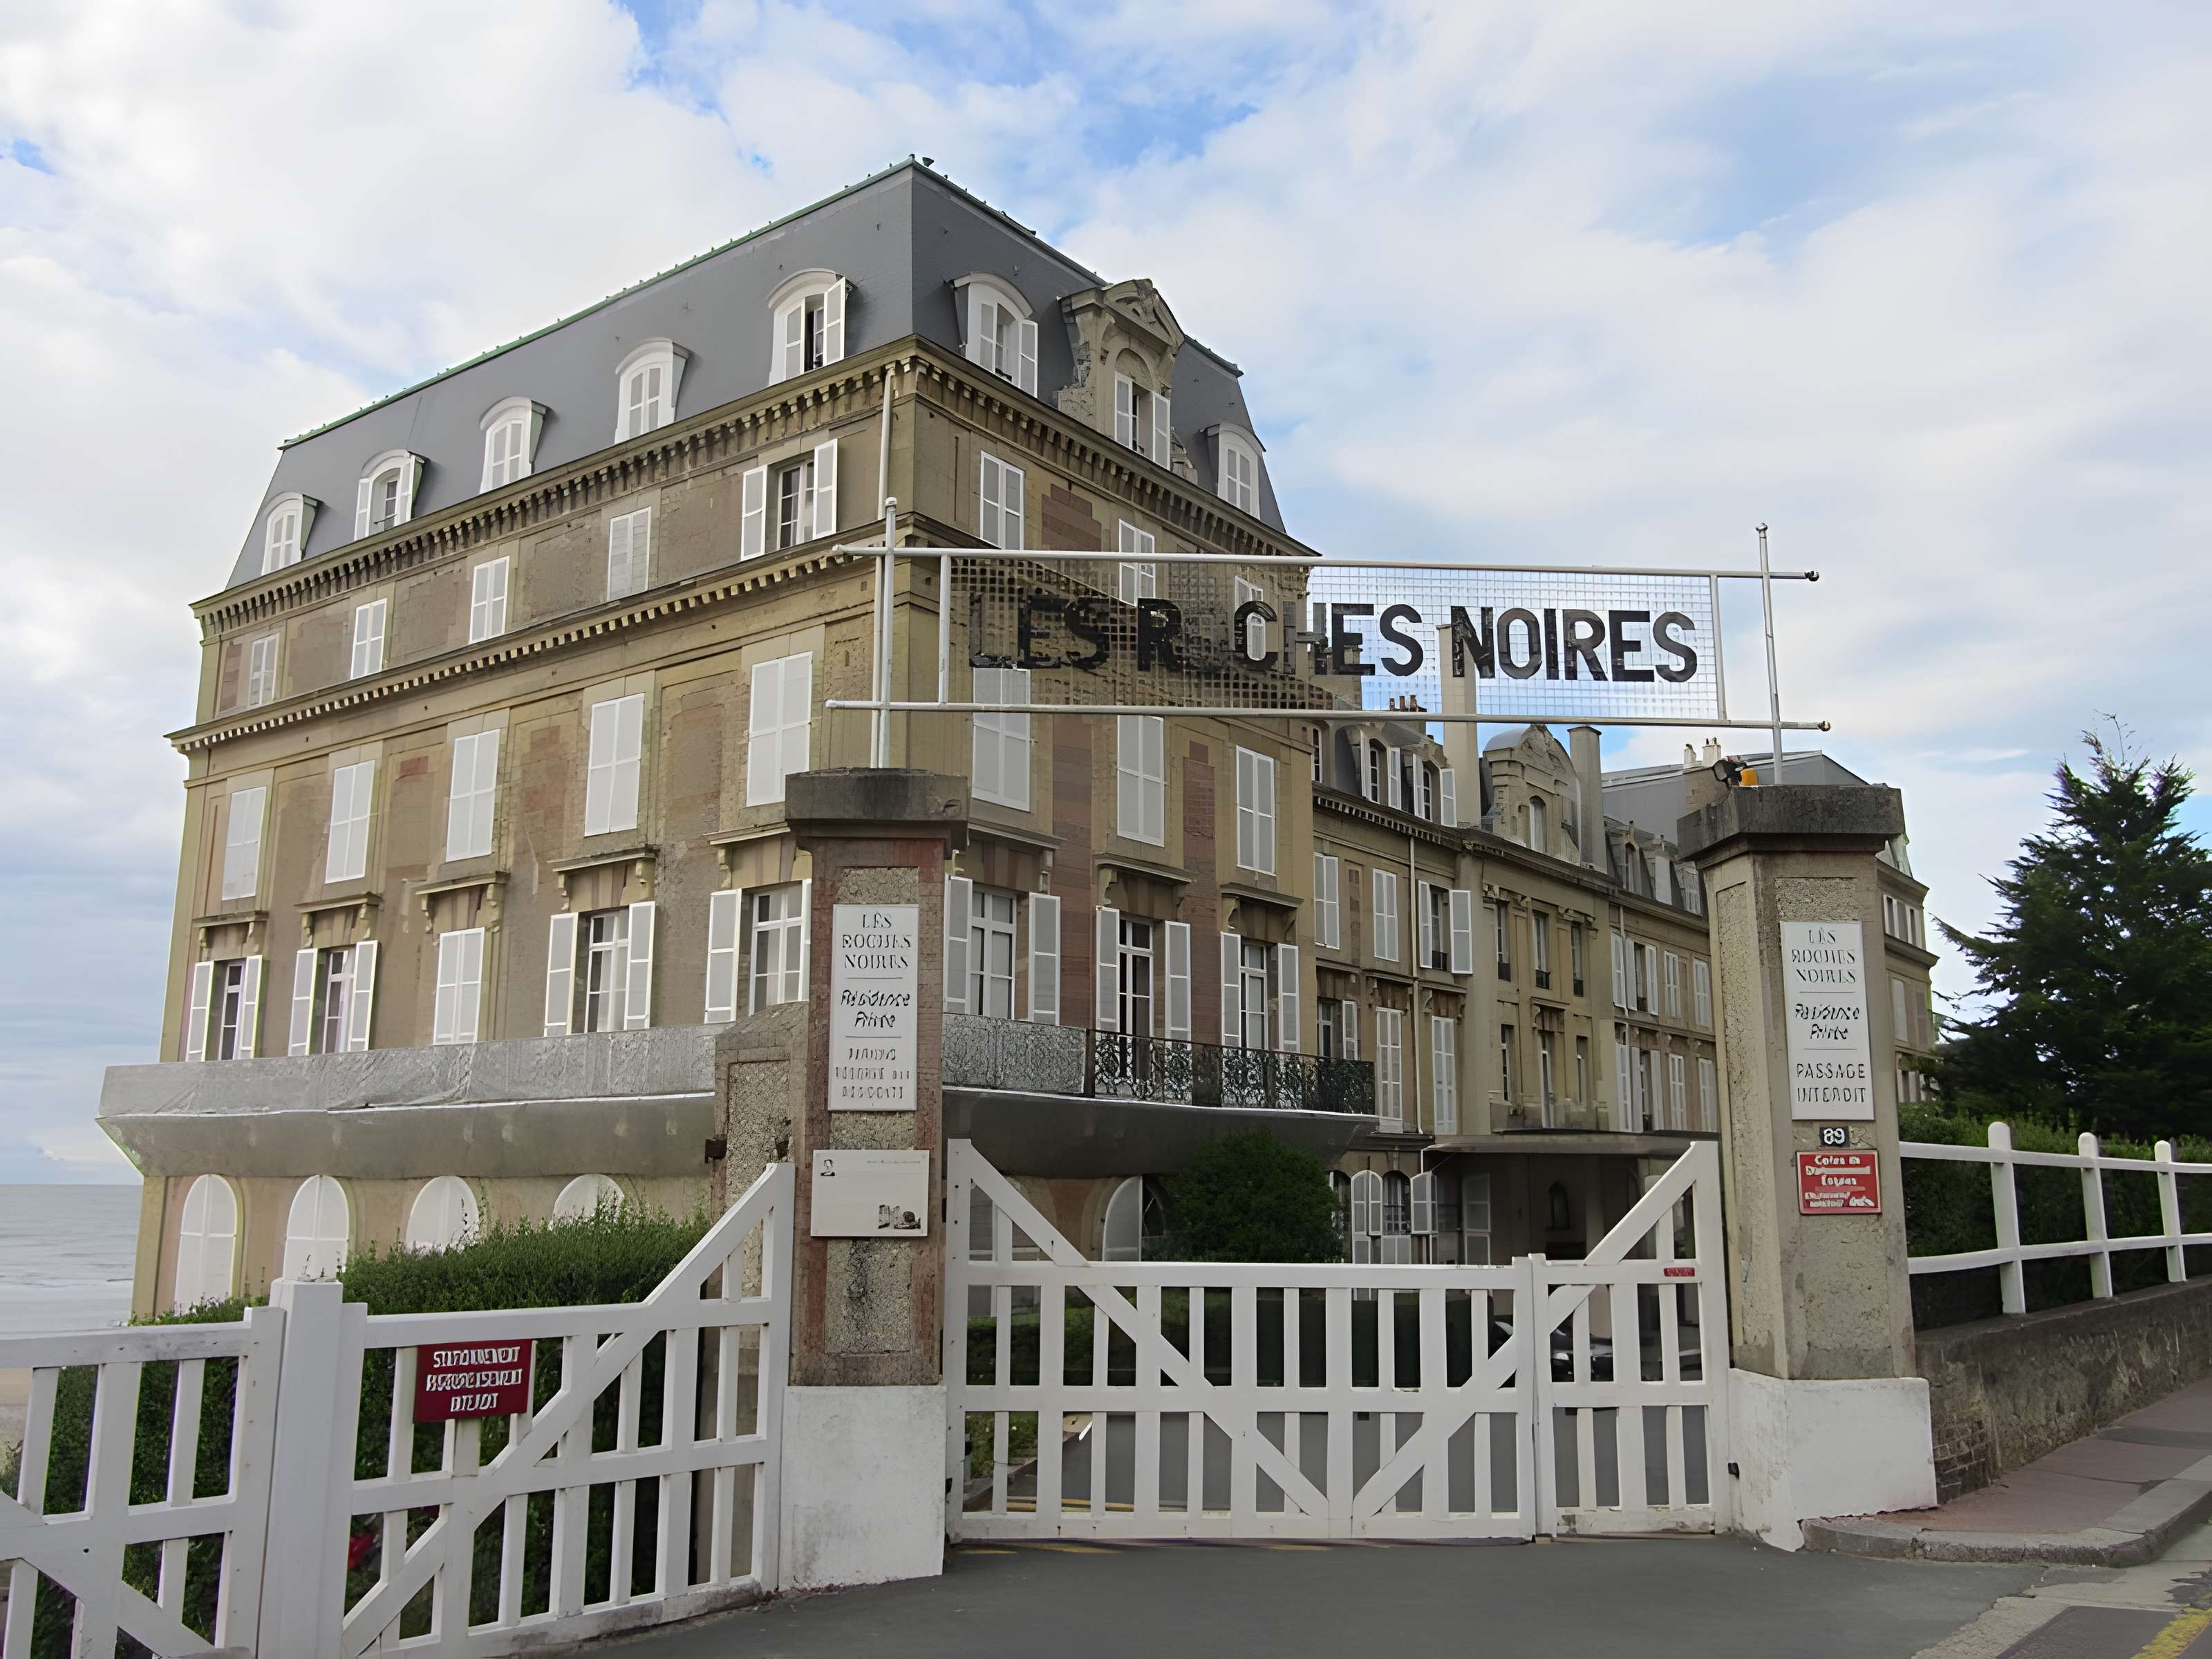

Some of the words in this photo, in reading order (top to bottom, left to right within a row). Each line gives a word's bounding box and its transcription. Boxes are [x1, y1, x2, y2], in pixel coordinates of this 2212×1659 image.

[1137, 598, 1424, 677] RCHES
[1450, 606, 1698, 682] NOIRES
[1796, 1062, 1866, 1079] PASSAGE
